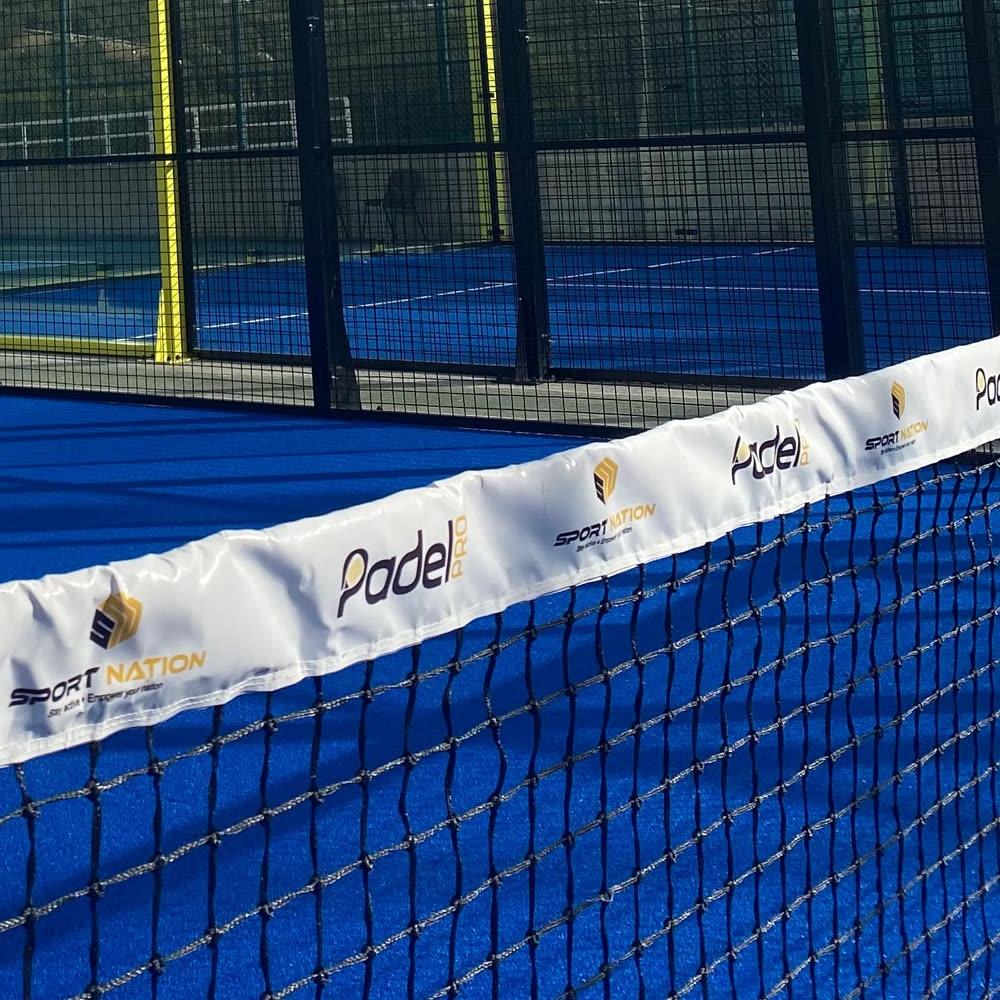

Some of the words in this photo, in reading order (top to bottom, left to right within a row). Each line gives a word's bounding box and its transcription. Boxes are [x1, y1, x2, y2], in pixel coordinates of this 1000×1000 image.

[864, 430, 899, 451] SPORT
[900, 420, 929, 440] NATION
[451, 515, 468, 579] PRO
[553, 519, 608, 547] SPORT
[608, 503, 656, 531] NATION
[336, 519, 453, 619] Padel
[8, 666, 100, 708] SPORT
[106, 651, 207, 686] NATION
